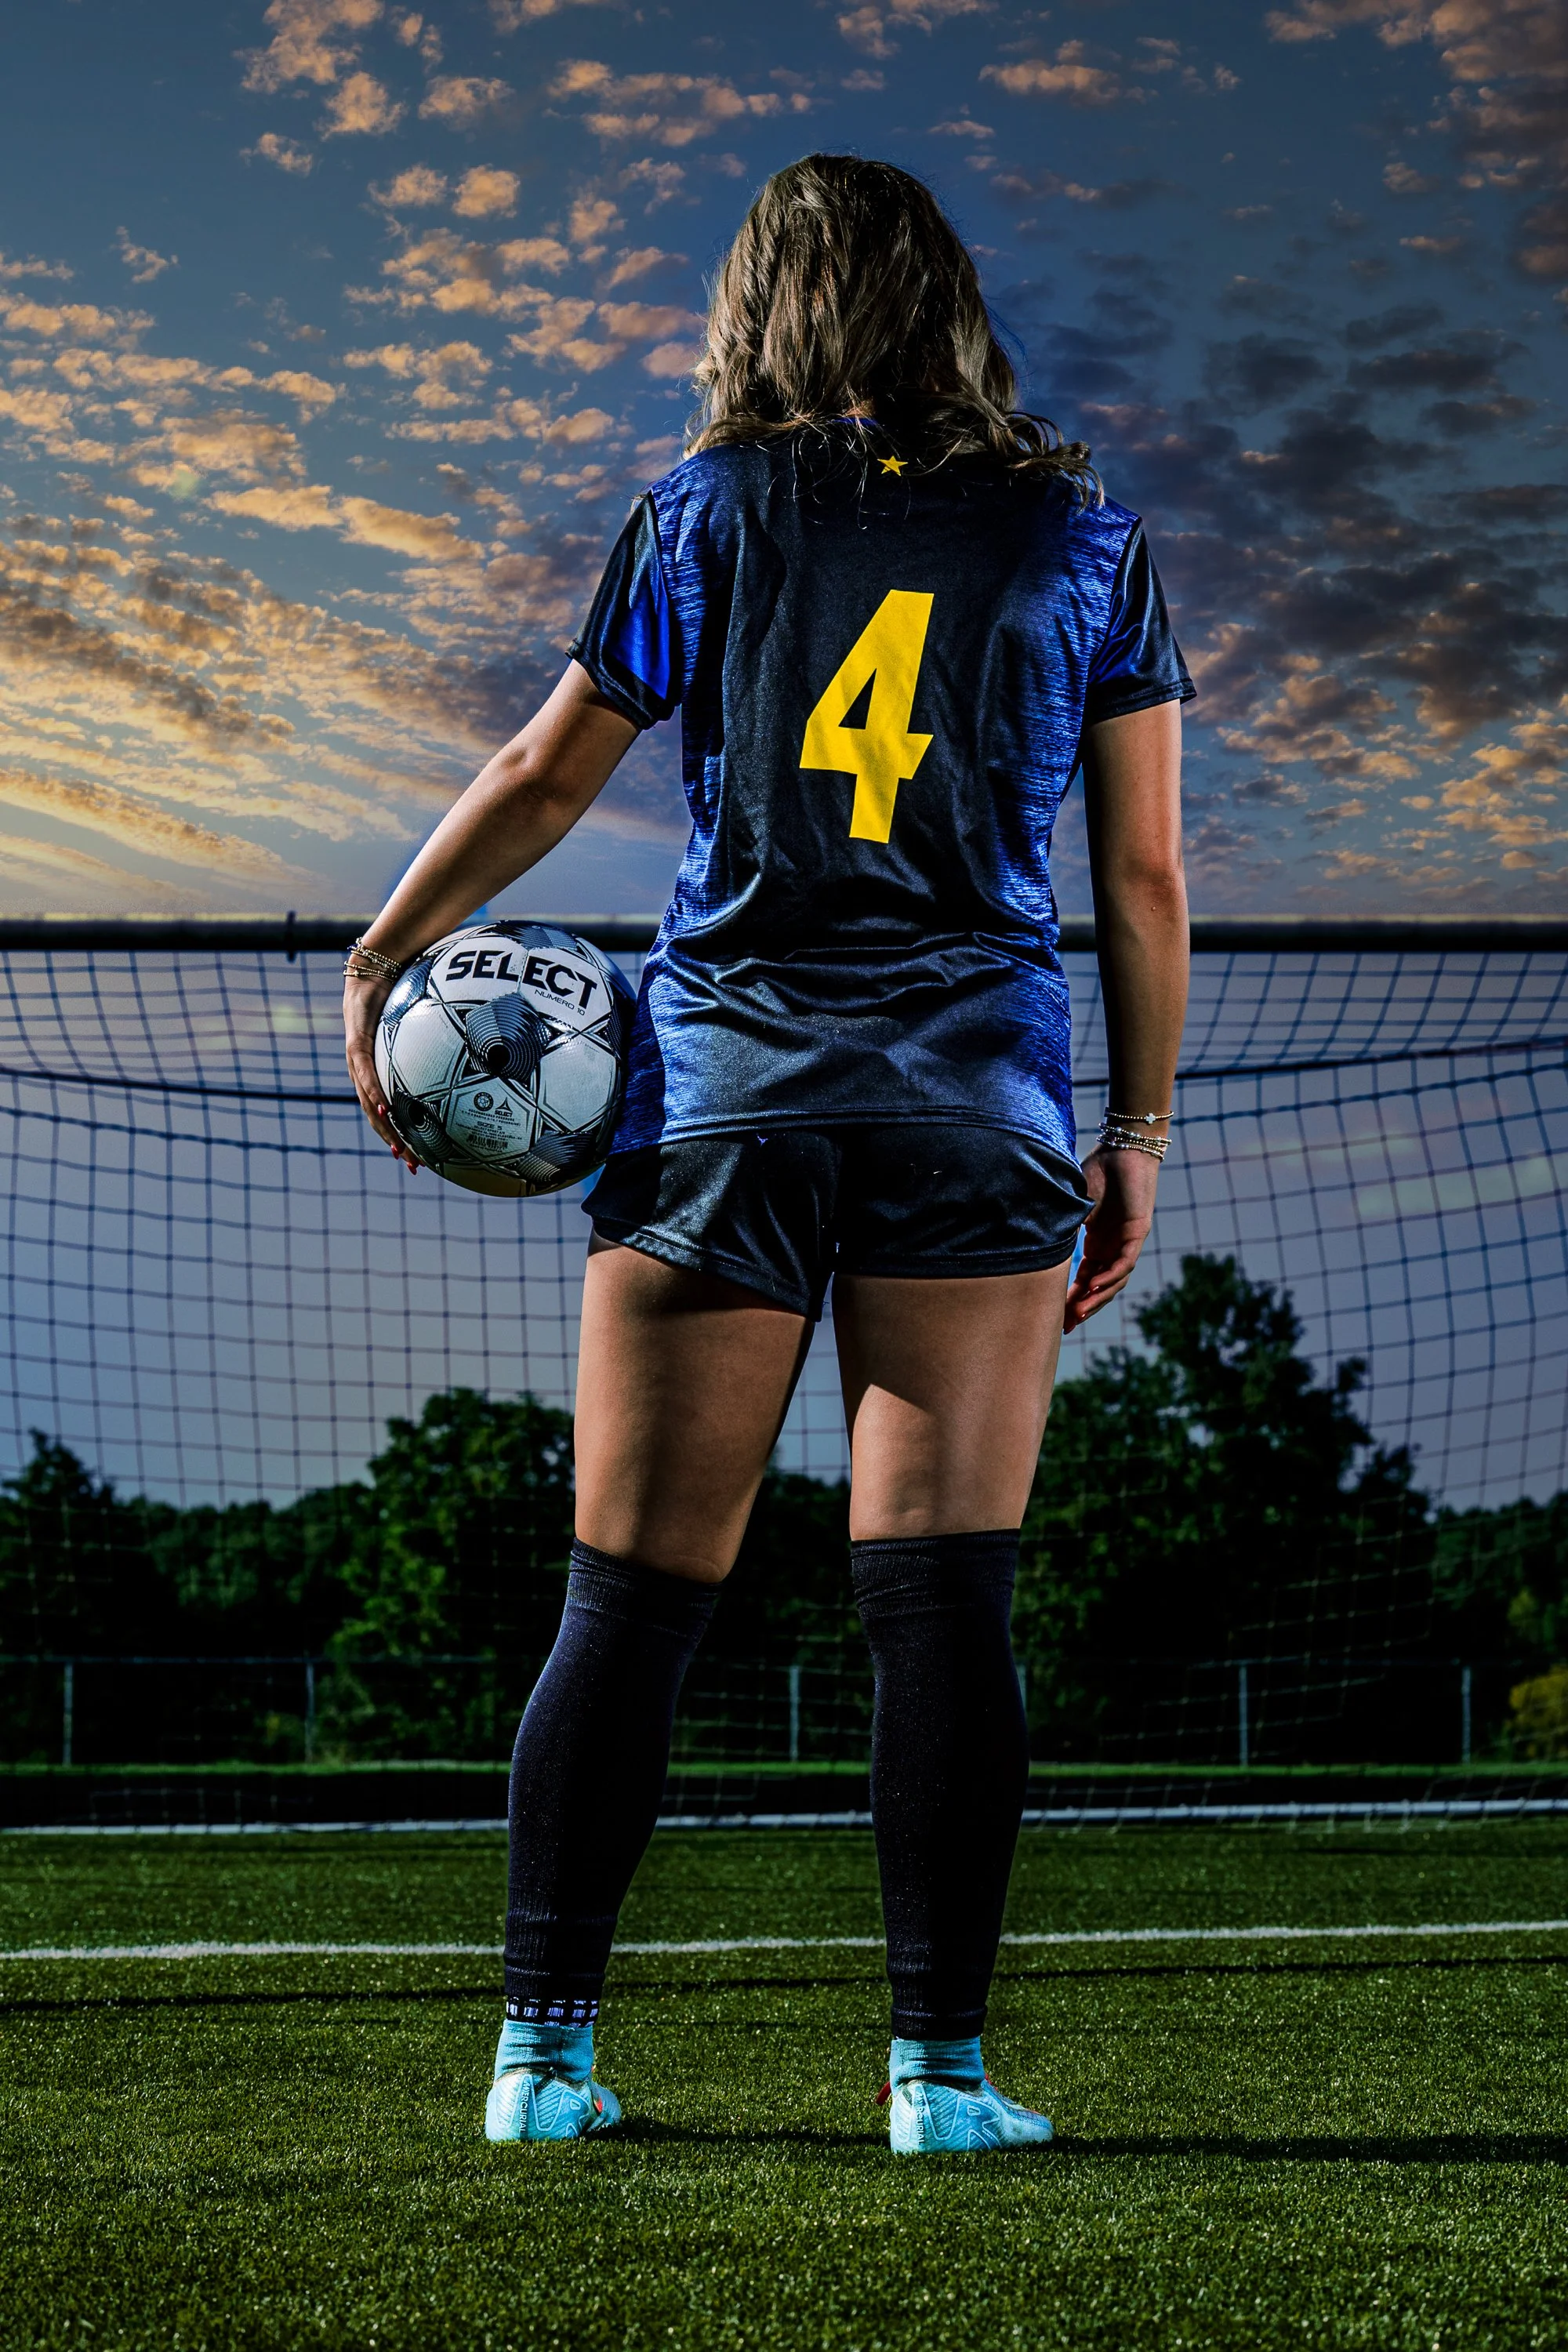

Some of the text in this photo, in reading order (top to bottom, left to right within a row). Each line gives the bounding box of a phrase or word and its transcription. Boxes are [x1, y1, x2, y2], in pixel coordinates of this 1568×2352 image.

[800, 590, 935, 844] 4
[445, 950, 597, 1010] SELECT
[534, 989, 586, 1017] NUMERO 10
[477, 1120, 495, 1129] SIZE
